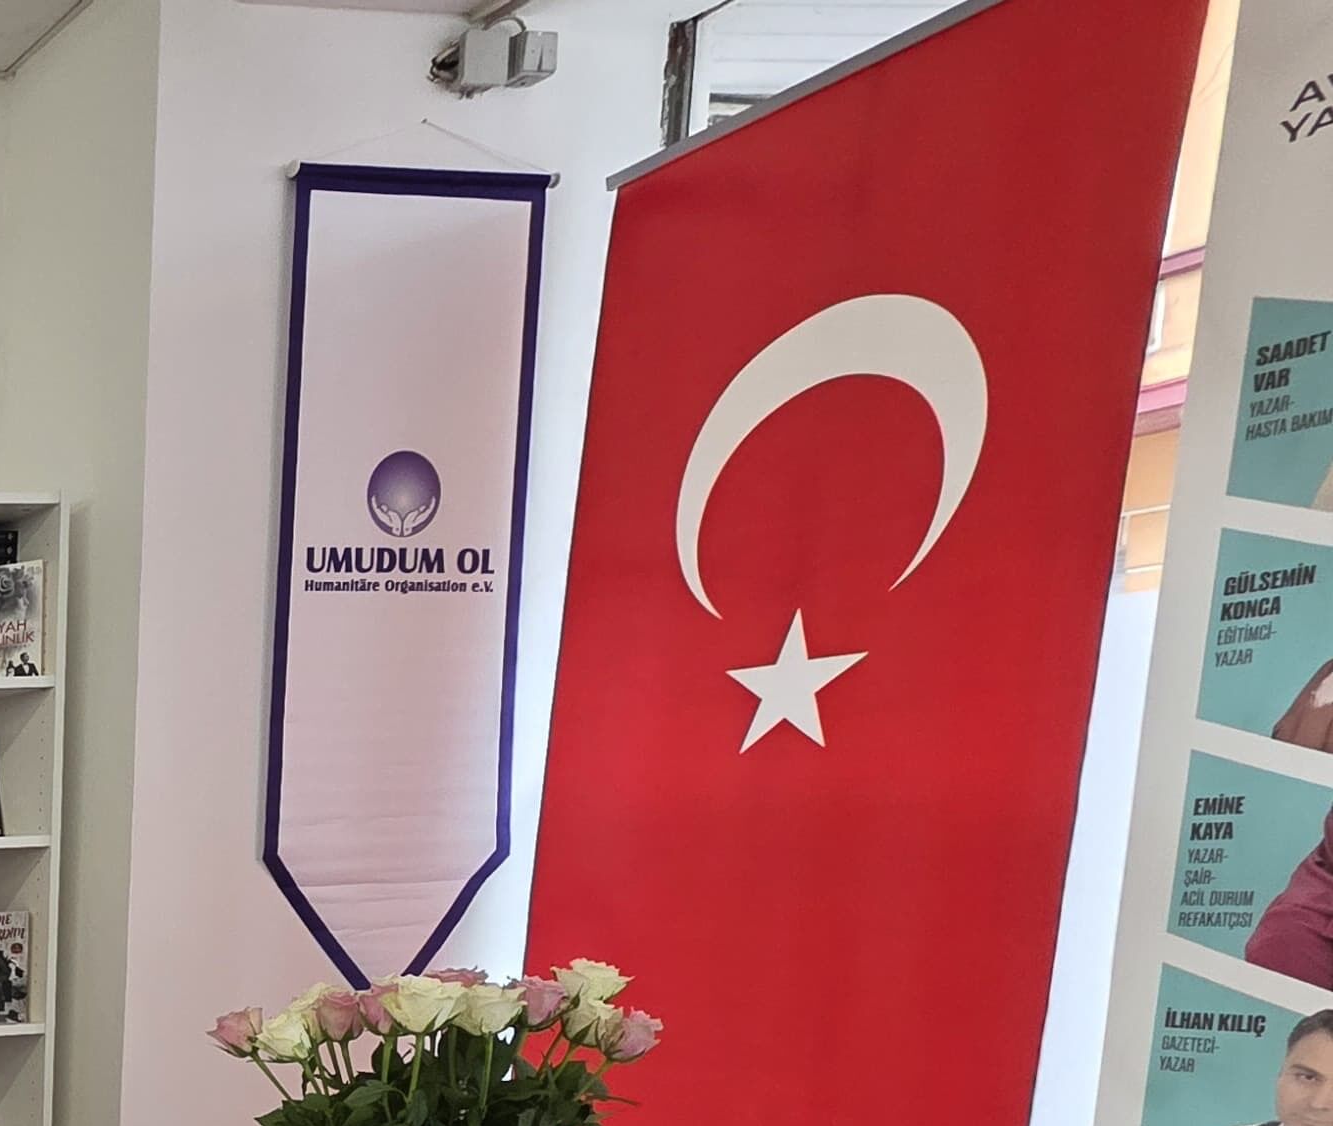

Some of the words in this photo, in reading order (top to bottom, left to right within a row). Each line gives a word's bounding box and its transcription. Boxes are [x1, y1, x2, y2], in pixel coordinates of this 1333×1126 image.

[1255, 330, 1332, 366] SAADET
[1254, 367, 1291, 393] VAR
[1245, 418, 1287, 441] HASTA
[305, 547, 445, 574] UMUDUM
[457, 548, 494, 574] OL
[304, 578, 380, 593] Humanitäre
[385, 578, 467, 595] Organisation
[471, 580, 494, 593] e.V.
[1223, 563, 1317, 596] GÜLSEMİN
[1220, 596, 1281, 622] KONCA
[1215, 648, 1253, 667] YAZAR
[1193, 793, 1245, 816] EMİNE
[1190, 822, 1233, 841] KAYA
[1180, 888, 1205, 906] ACİL
[1209, 890, 1254, 906] DURUM
[1165, 1007, 1214, 1030] İLHAN
[1217, 1013, 1266, 1038] KILIÇ
[1159, 1055, 1195, 1072] YAZAR
